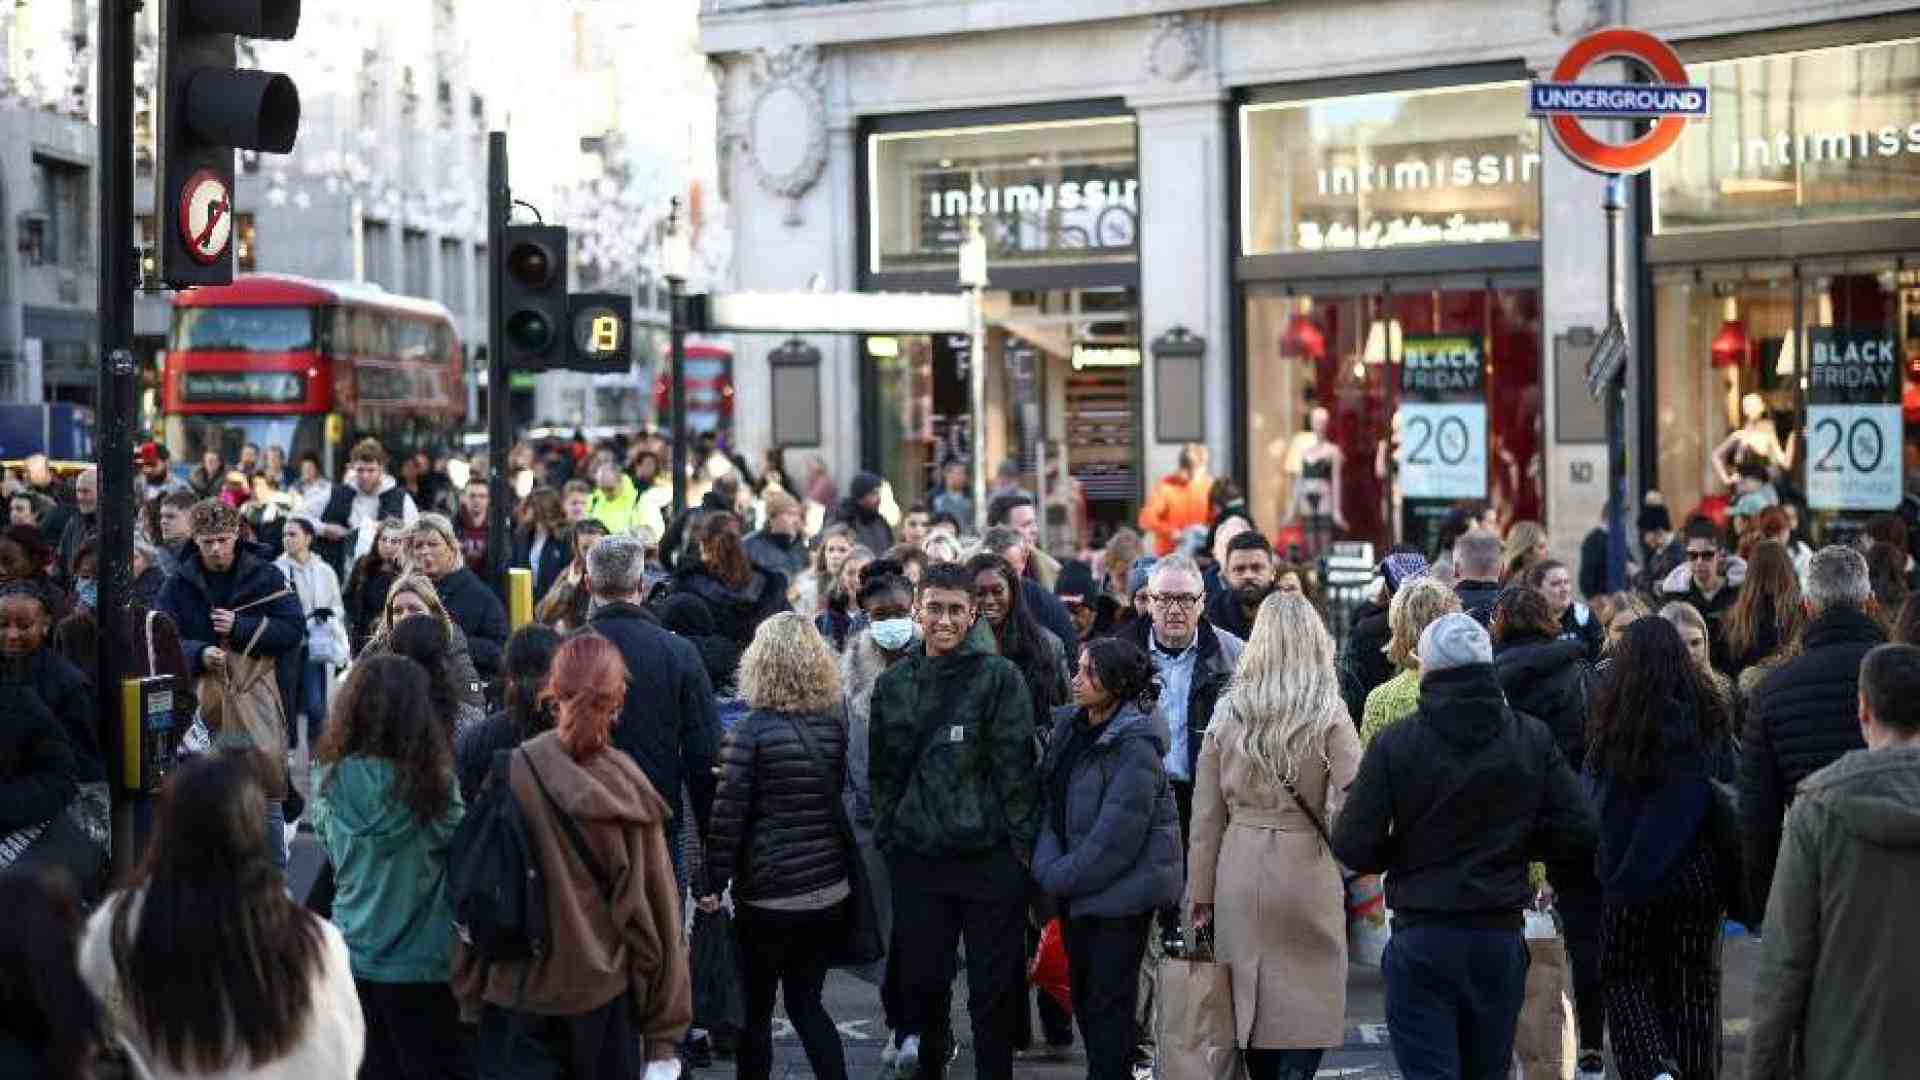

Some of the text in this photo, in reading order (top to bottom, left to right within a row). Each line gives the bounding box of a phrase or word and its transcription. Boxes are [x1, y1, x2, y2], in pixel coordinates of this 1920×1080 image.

[1538, 88, 1701, 110] UNDERGROUND
[592, 316, 618, 351] 8
[1404, 347, 1480, 370] BLACK
[1814, 340, 1894, 364] BLACK
[1403, 368, 1477, 389] FRIDAY
[1812, 364, 1893, 387] FRIDAY
